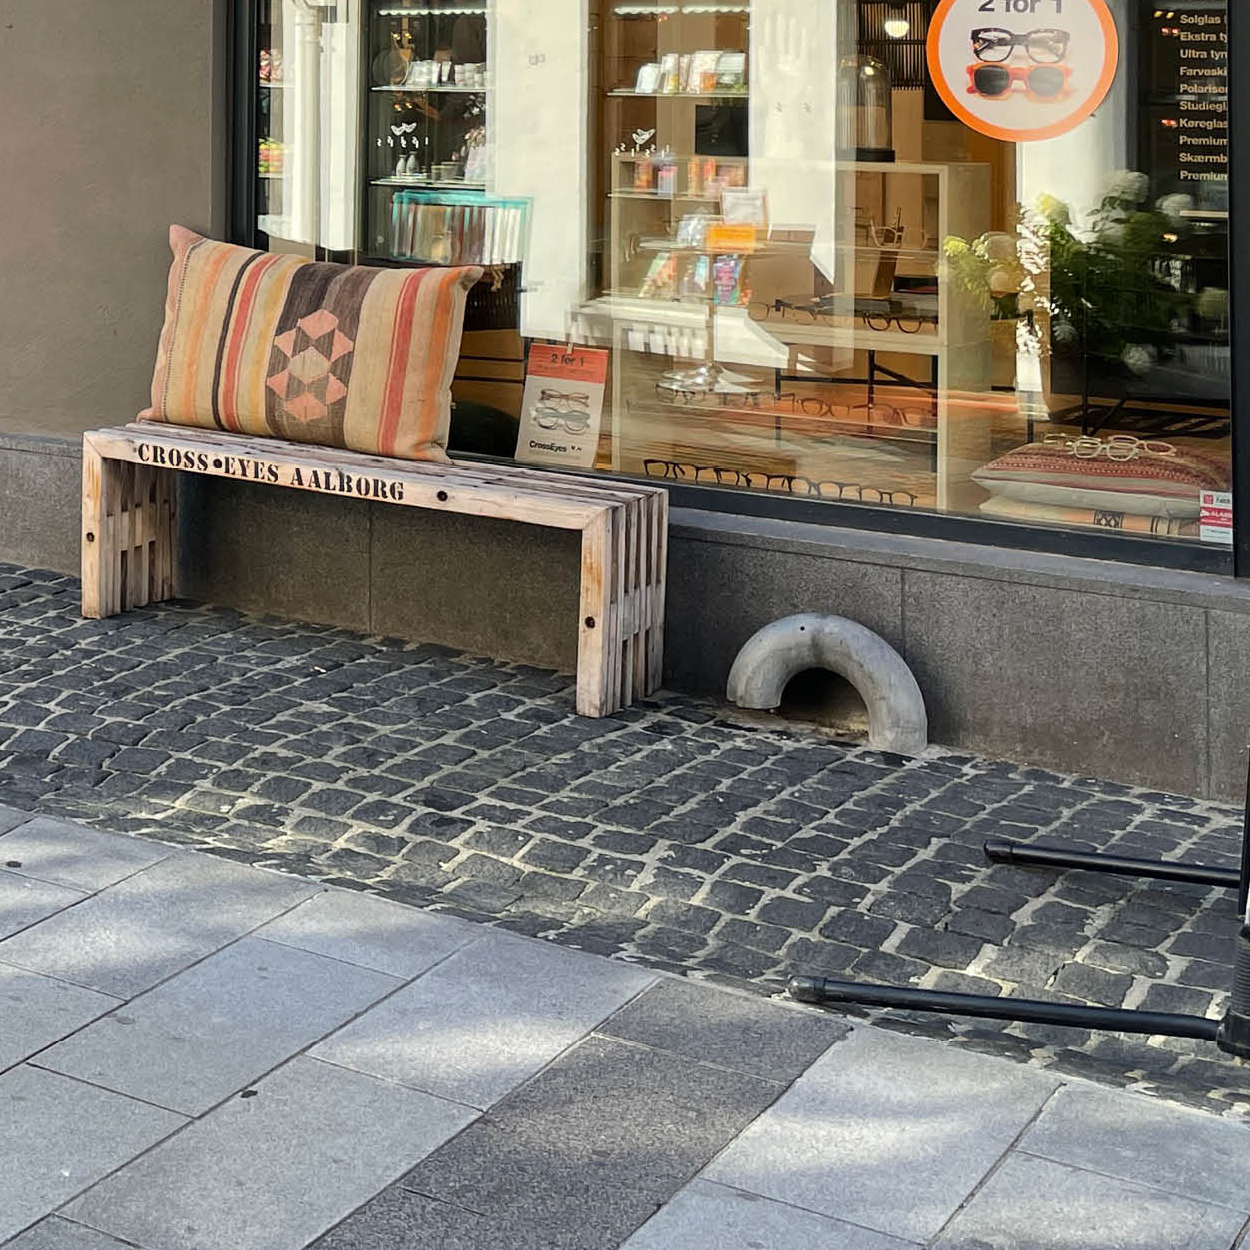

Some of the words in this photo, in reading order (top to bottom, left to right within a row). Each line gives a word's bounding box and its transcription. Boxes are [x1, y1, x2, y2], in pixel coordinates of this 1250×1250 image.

[551, 353, 559, 364] 2
[561, 355, 576, 366] for
[579, 356, 586, 367] 1
[136, 442, 210, 472] CROSS
[224, 455, 280, 484] EYES
[289, 466, 406, 502] AALBORG
